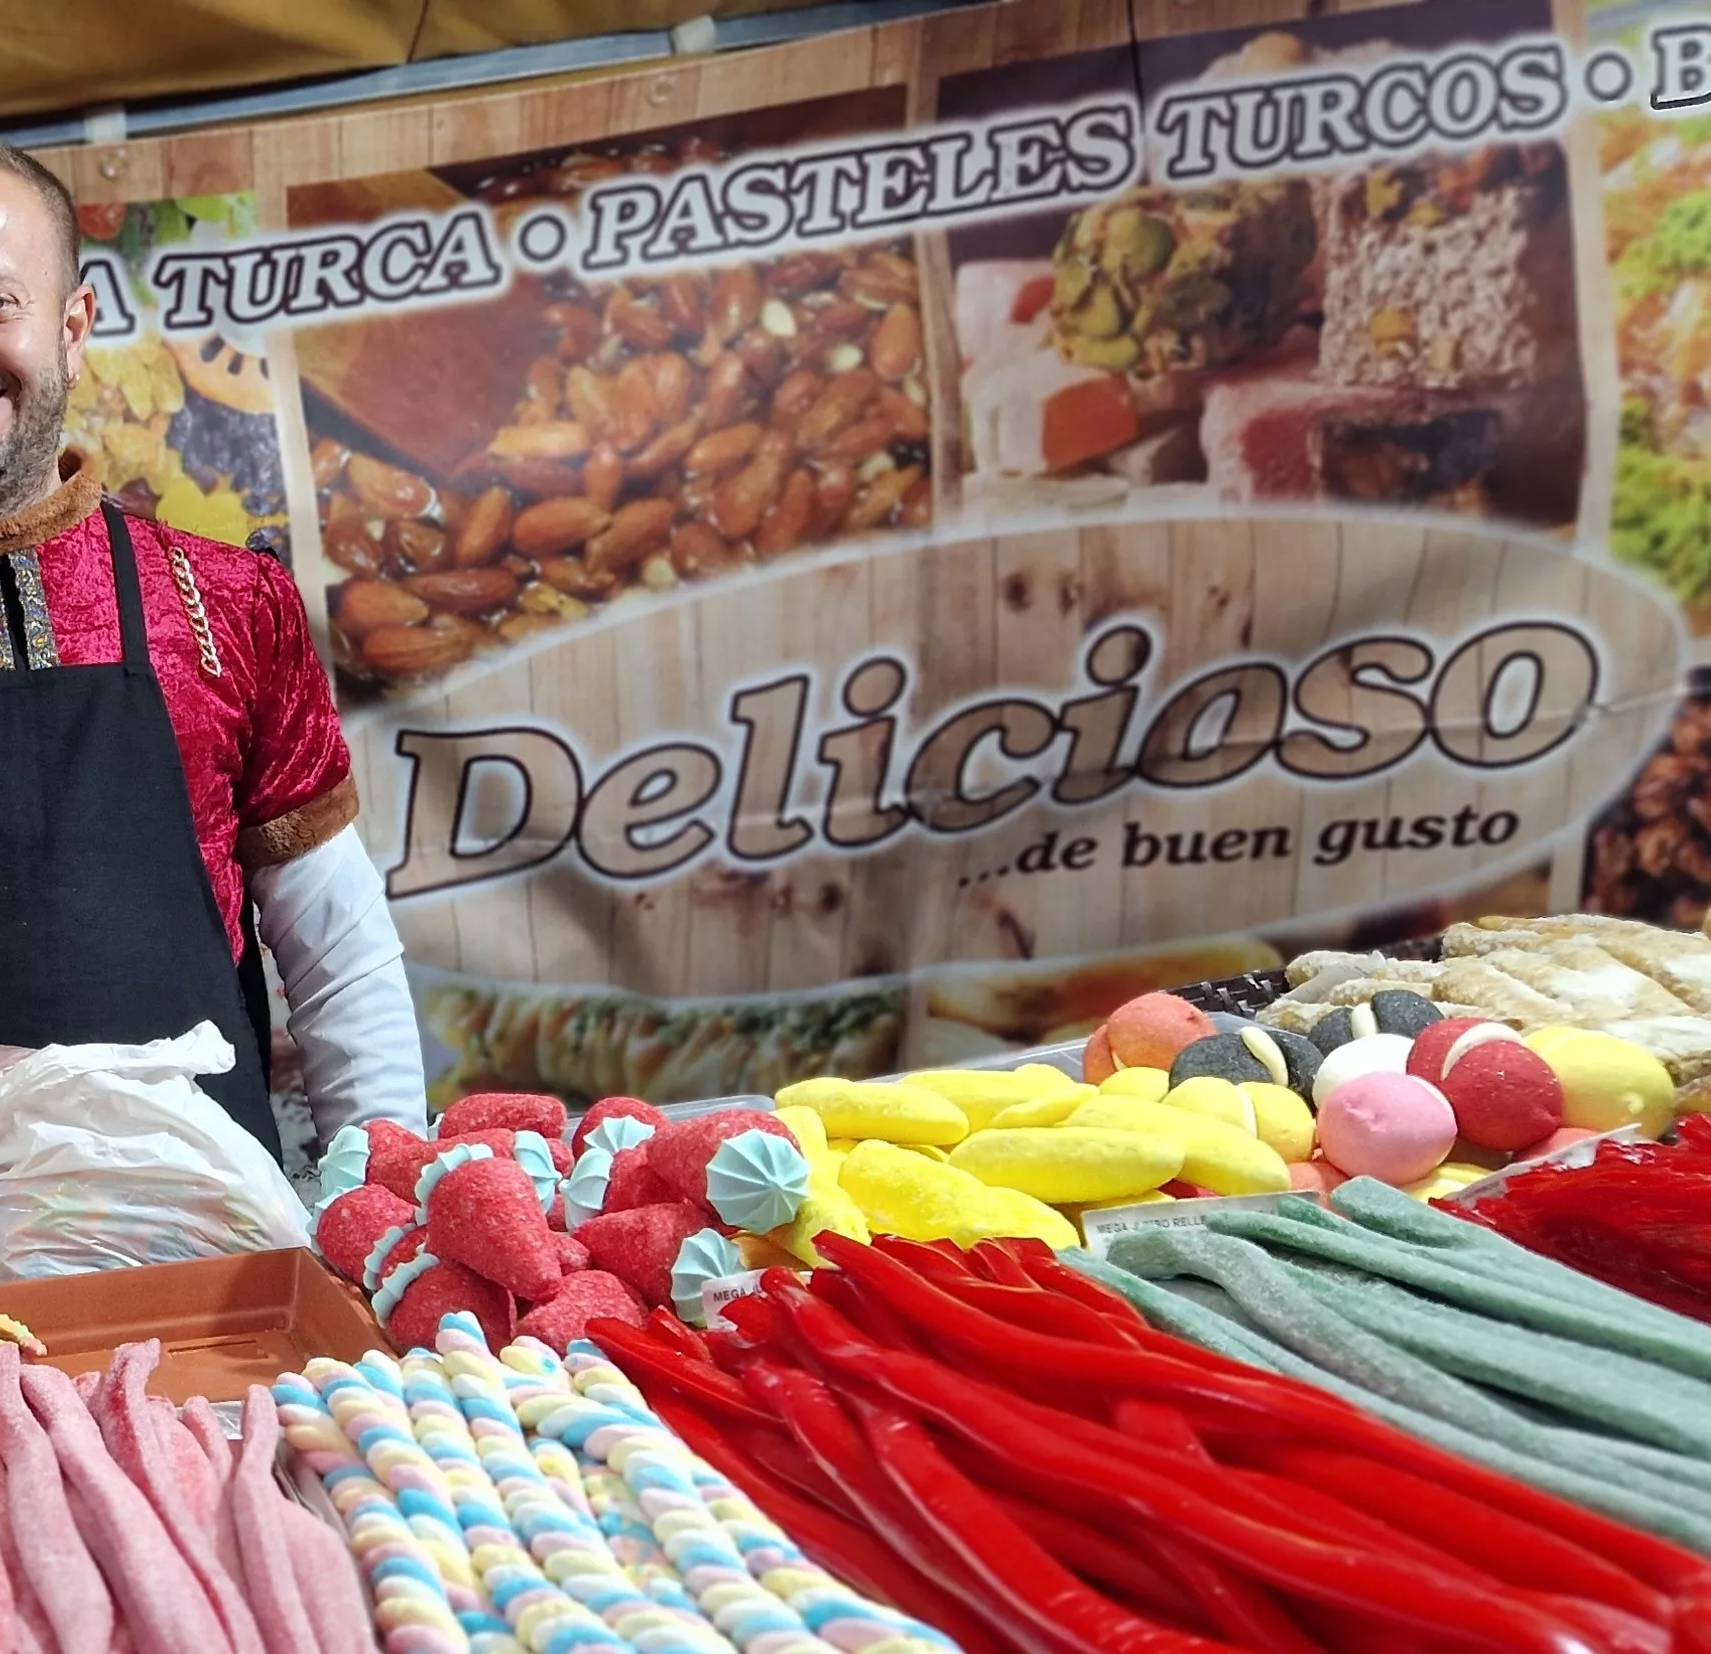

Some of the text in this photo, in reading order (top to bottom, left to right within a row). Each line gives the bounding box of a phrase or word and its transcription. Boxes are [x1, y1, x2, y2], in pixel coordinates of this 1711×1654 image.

[153, 212, 502, 330] TURCA
[583, 103, 1135, 270] PASTELES
[1157, 43, 1568, 181] TURCOS
[385, 620, 1599, 898] Delicioso
[1121, 822, 1291, 868] buen
[1313, 804, 1521, 866] gusto
[713, 1287, 747, 1301] MEGA
